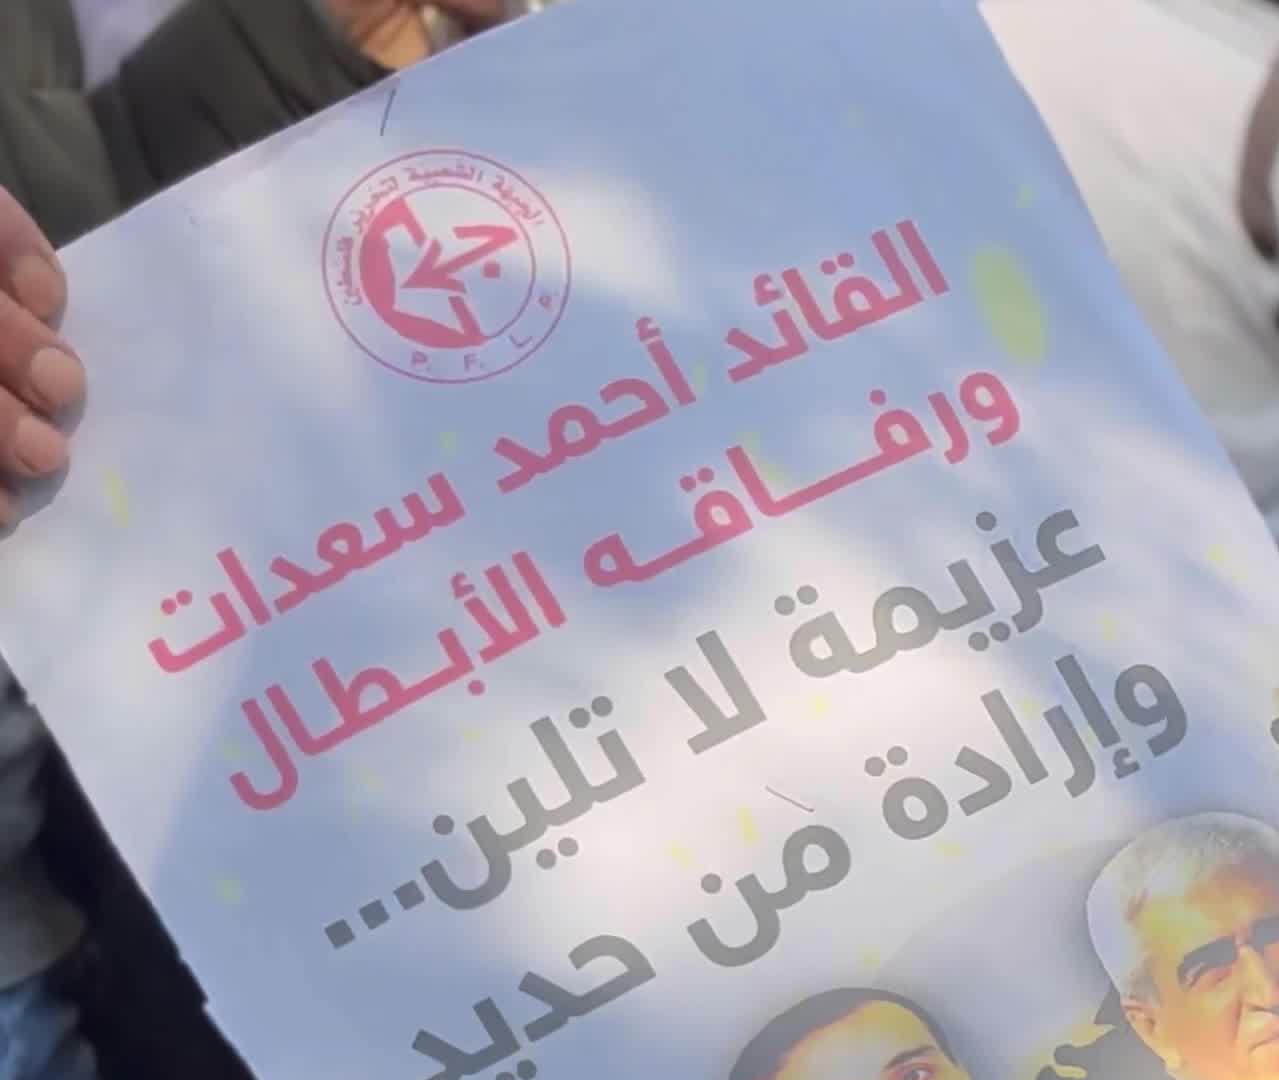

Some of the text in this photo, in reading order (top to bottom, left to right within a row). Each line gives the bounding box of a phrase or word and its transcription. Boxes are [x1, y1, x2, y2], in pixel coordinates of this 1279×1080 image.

[148, 219, 951, 674] القائد أحمد سعدات
[773, 507, 1108, 679] عزيمة
[662, 628, 768, 756] لا
[863, 651, 1190, 842] وإرادة
[685, 823, 853, 968] من
